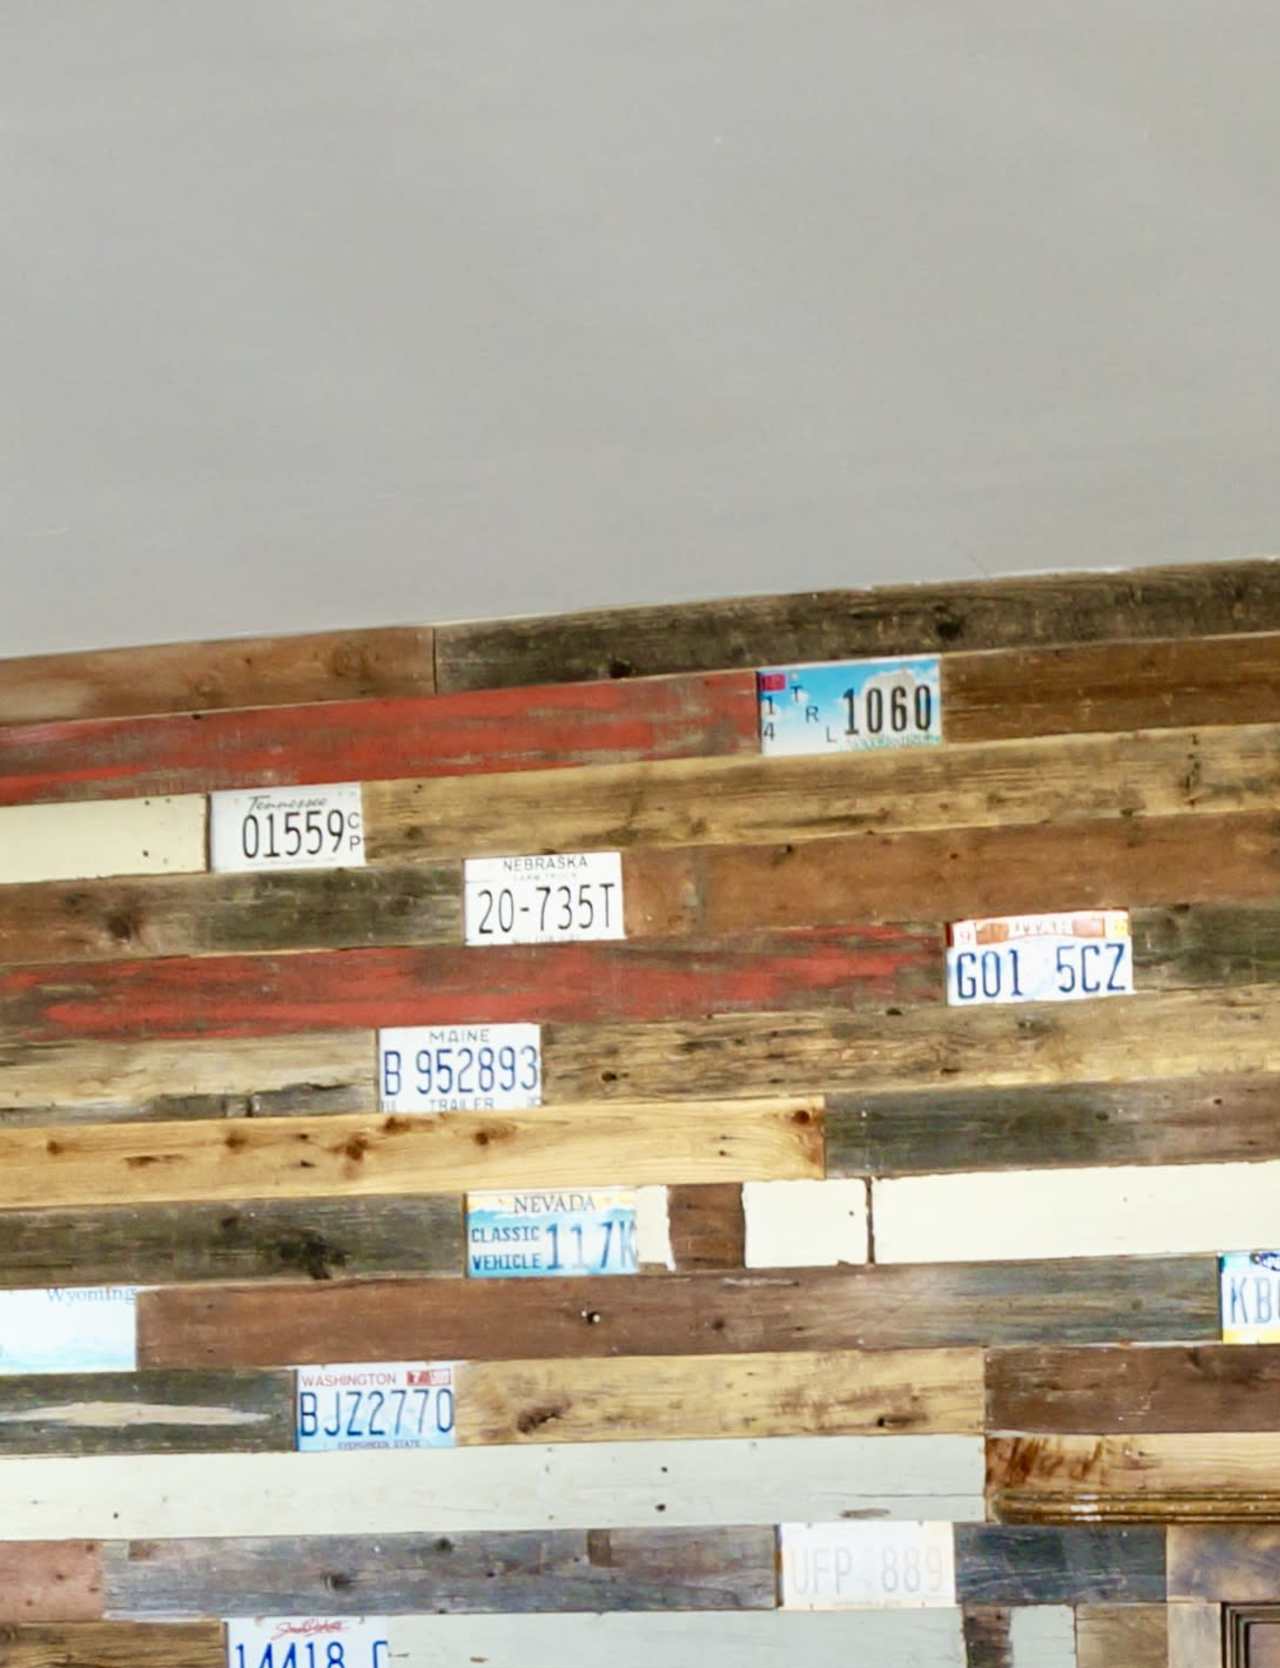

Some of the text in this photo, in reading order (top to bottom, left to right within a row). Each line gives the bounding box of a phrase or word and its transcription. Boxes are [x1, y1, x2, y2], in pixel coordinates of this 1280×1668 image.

[843, 684, 932, 735] 1060
[248, 794, 328, 813] Tennessee
[242, 809, 344, 859] 01559
[503, 855, 589, 872] NEBRASKA
[478, 883, 615, 934] 20-735T
[1056, 943, 1126, 993] 5CZ
[429, 1029, 491, 1043] MAINE
[384, 1045, 538, 1096] B 952893
[513, 1194, 596, 1214] NEVADA
[471, 1225, 540, 1243] CLASSIC
[472, 1253, 542, 1271] VEHICLE
[47, 1287, 137, 1306] Wyoming
[301, 1372, 397, 1387] WASHINGTON
[300, 1388, 455, 1437] BJZ2770
